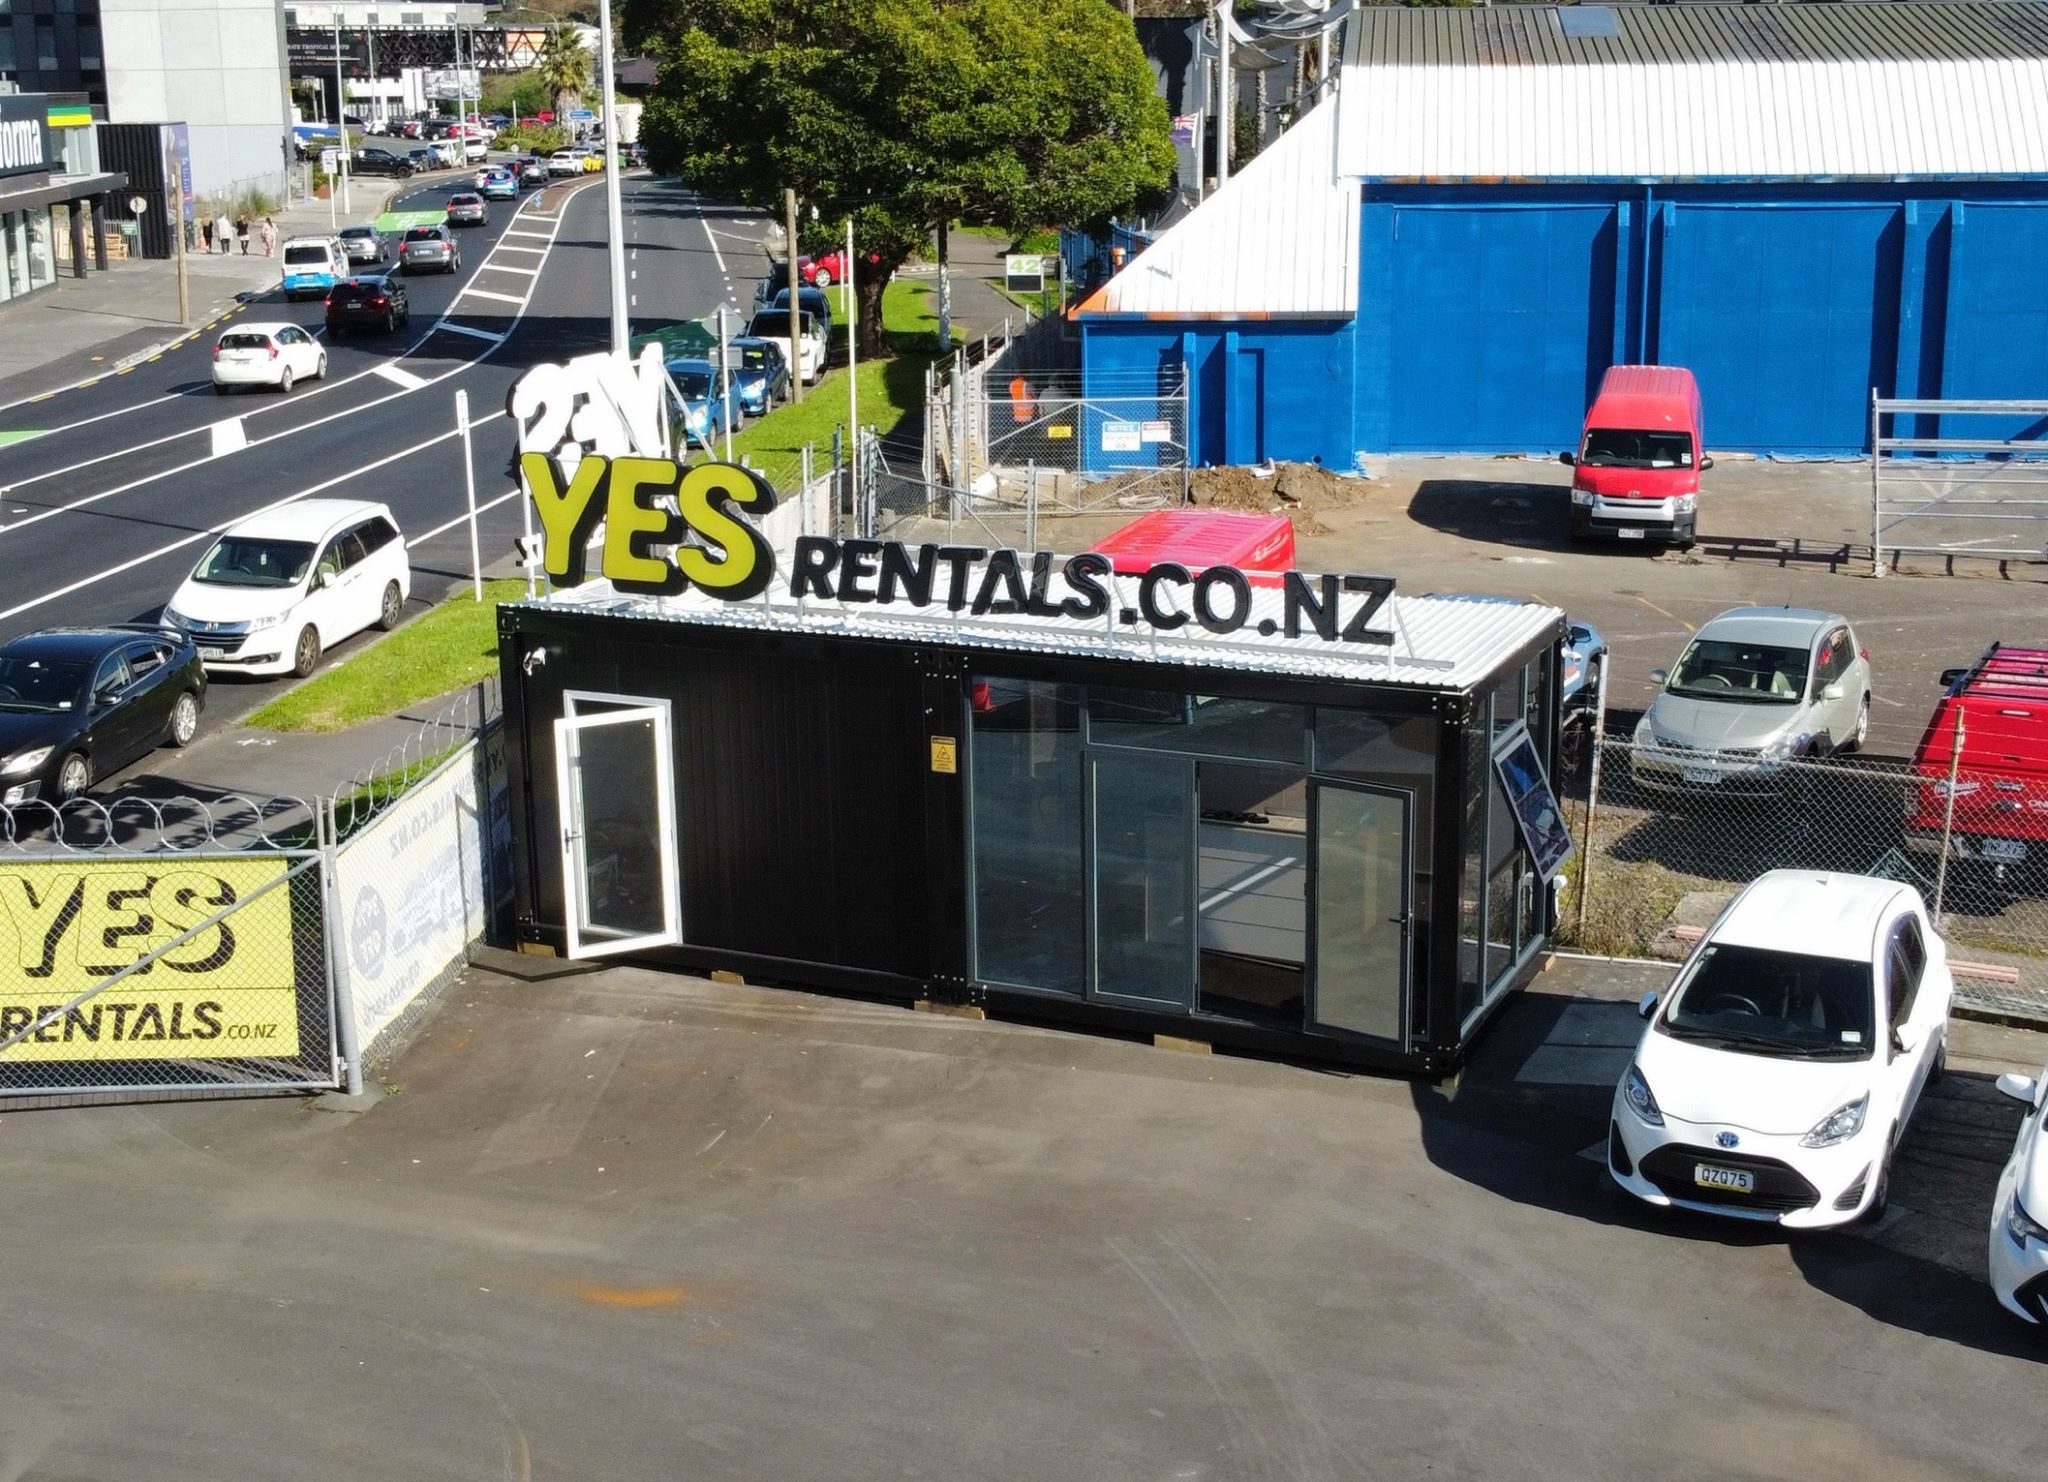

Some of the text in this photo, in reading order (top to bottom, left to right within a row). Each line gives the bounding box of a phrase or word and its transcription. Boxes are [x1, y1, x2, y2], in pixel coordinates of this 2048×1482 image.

[1010, 259, 1040, 273] 42
[520, 452, 1395, 647] YES RENTALS.CO.NZ
[0, 871, 237, 978] YES
[0, 1001, 278, 1043] RENTALS.CO.NZ
[1702, 1168, 1747, 1188] QZQ75
